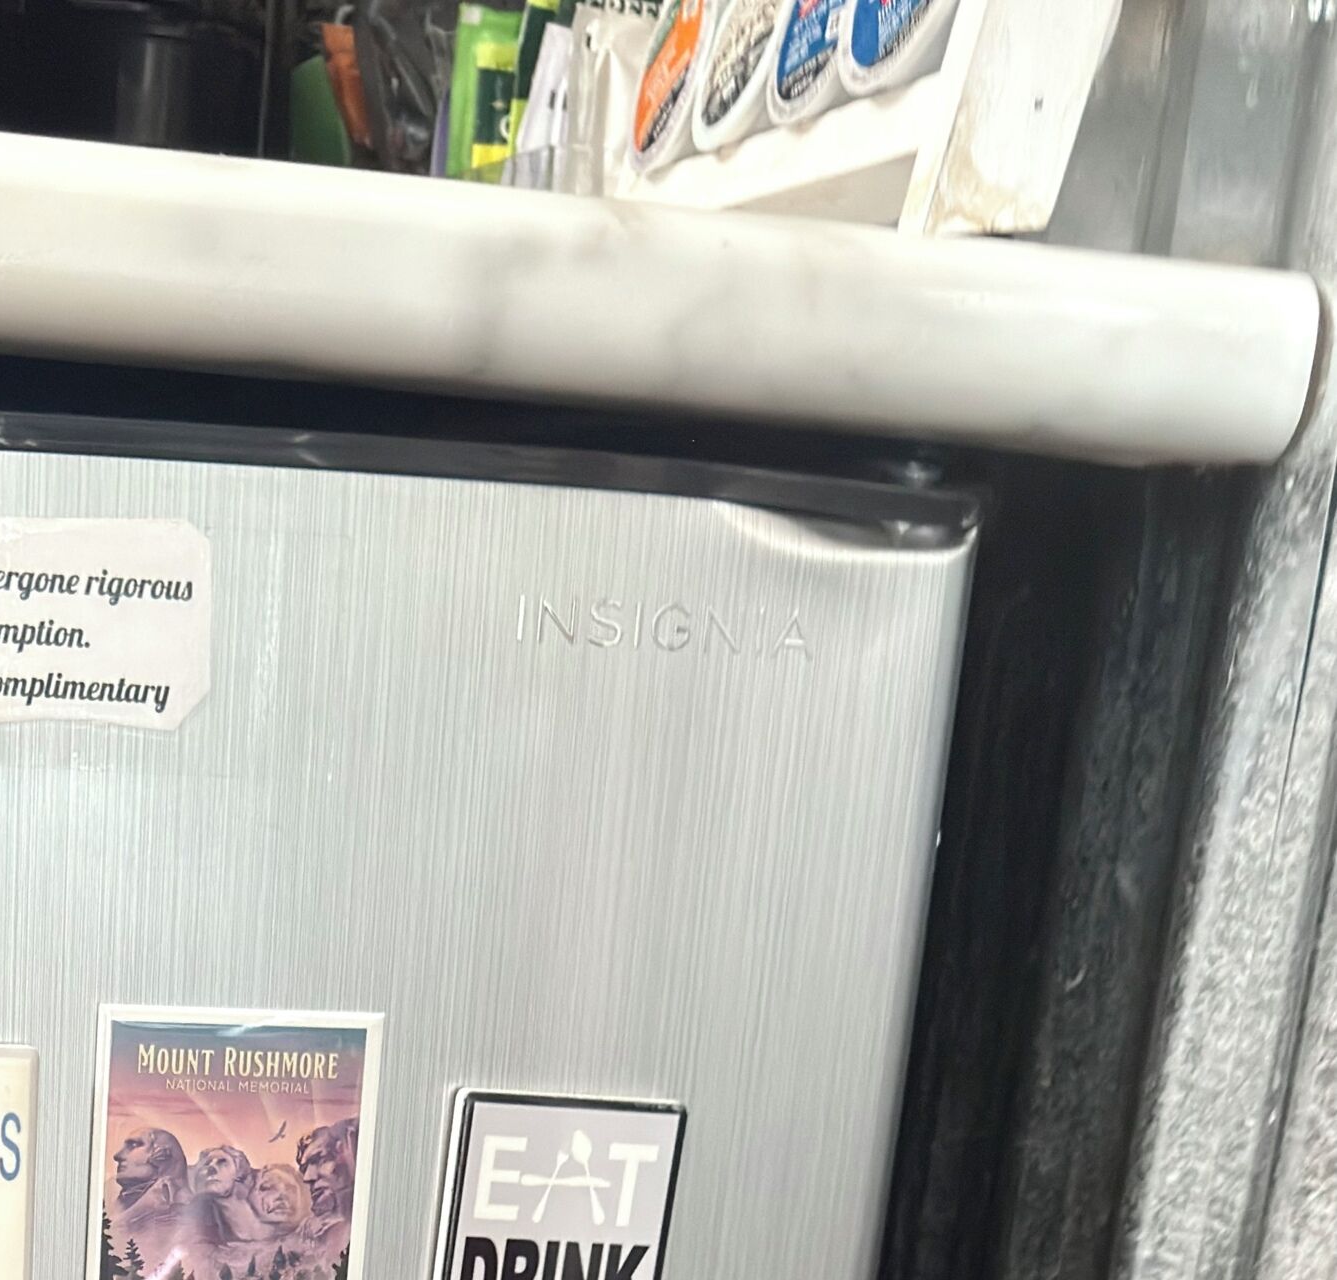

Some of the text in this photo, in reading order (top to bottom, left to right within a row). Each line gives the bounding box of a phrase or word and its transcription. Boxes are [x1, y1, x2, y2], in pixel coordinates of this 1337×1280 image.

[84, 569, 193, 606] rigorous
[516, 594, 812, 662] INSIGNIA
[137, 1043, 339, 1080] MOUNT RUSHMORE
[165, 1078, 310, 1095] NATIONAL MEMORIAL
[473, 1129, 660, 1227] EAT
